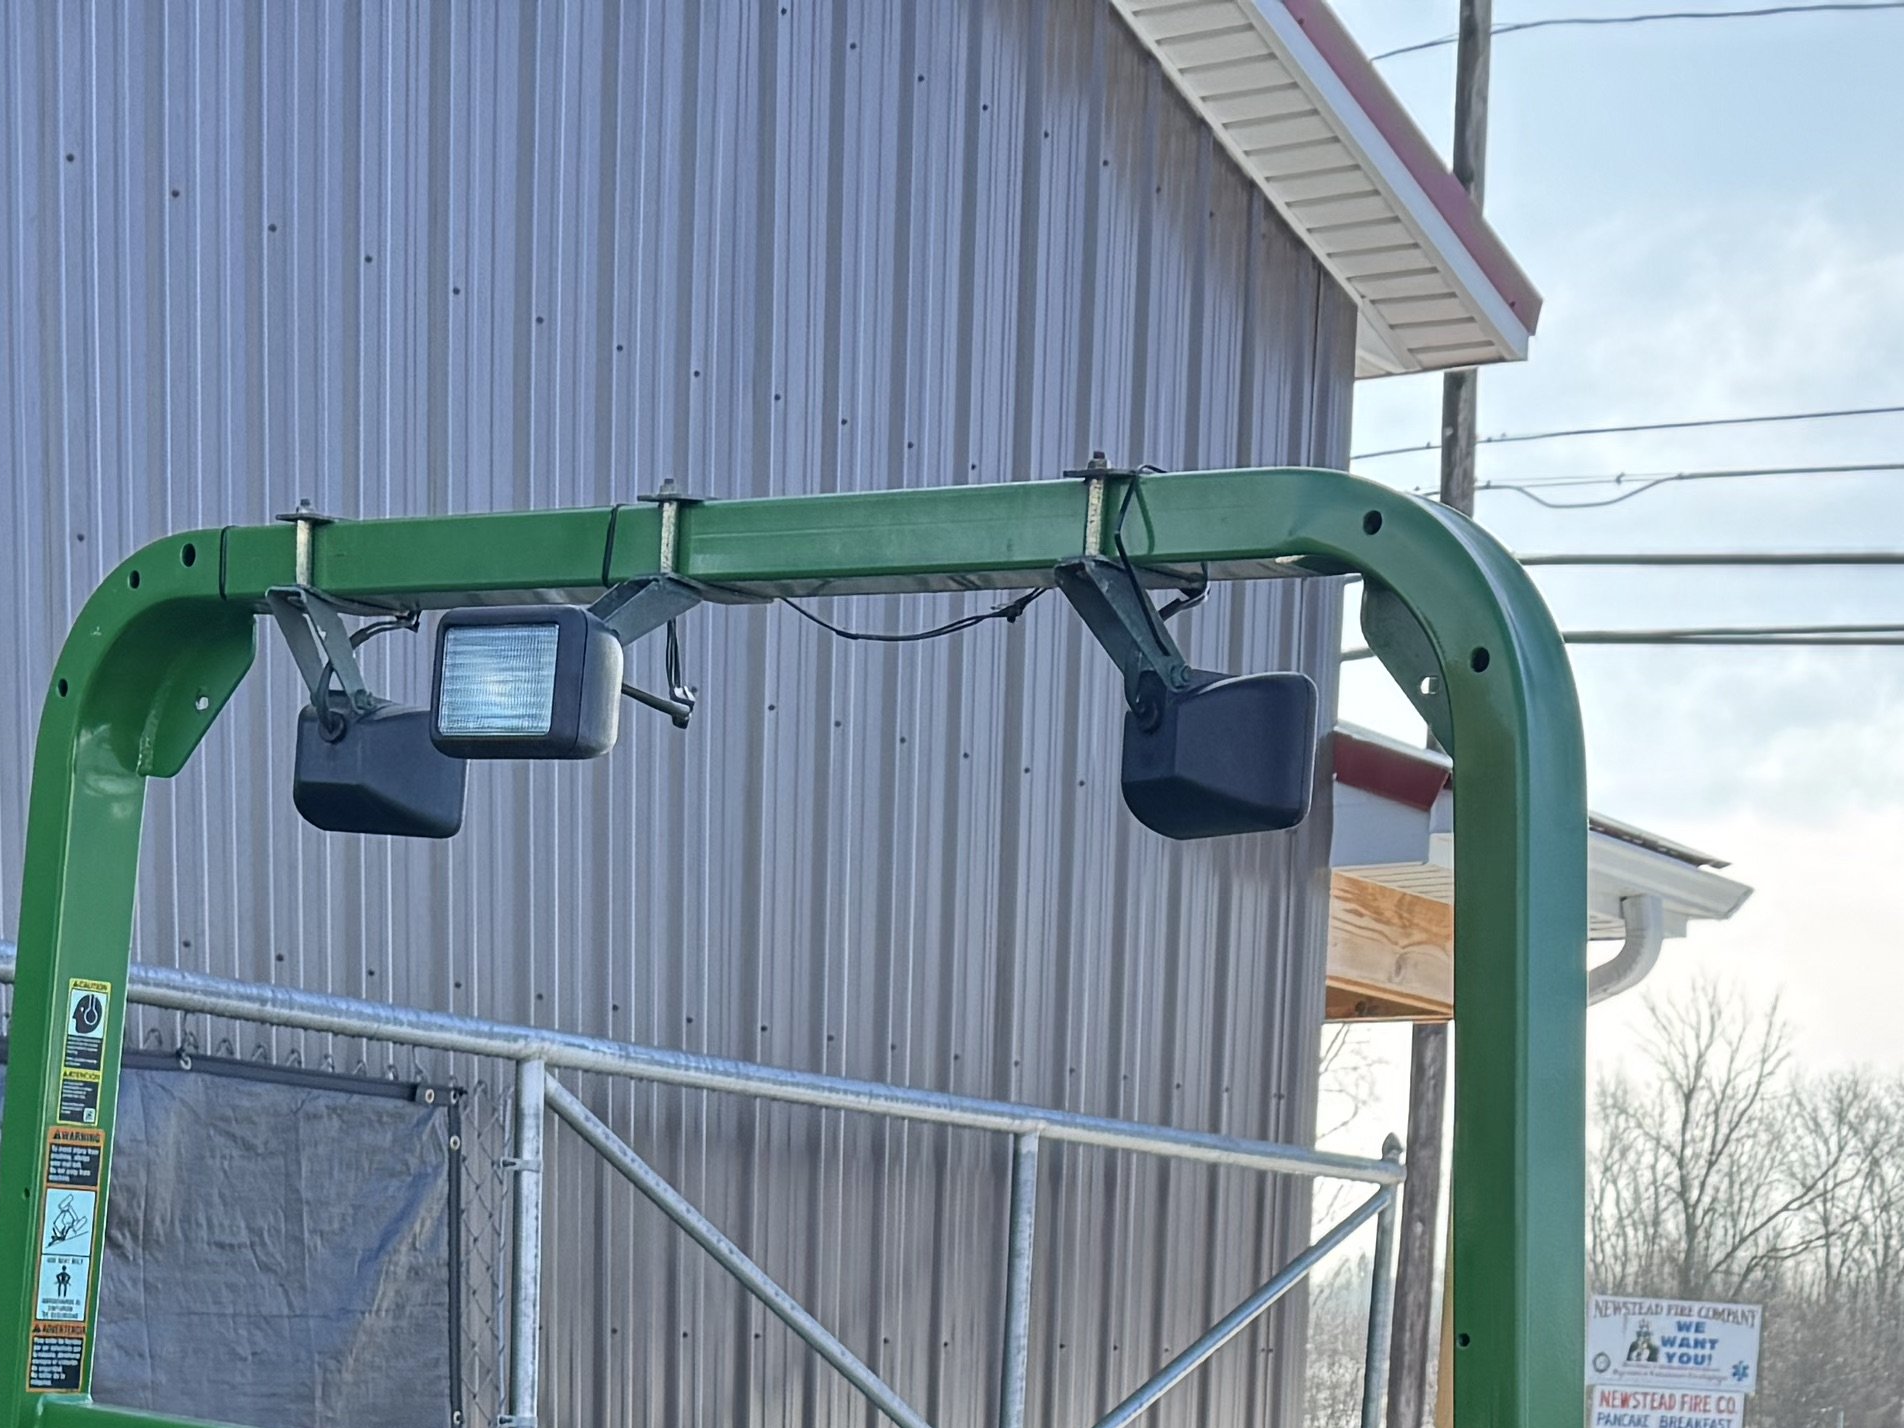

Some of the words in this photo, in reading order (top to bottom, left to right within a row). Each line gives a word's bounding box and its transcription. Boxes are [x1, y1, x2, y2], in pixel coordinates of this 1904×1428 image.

[1594, 1299, 1663, 1318] NEWSTEAD
[1666, 1302, 1694, 1317] FIRE
[1697, 1304, 1758, 1328] COMPANY
[1676, 1320, 1706, 1333] WE
[1661, 1335, 1719, 1350] WANT
[1665, 1352, 1712, 1366] YOU!
[1599, 1390, 1676, 1411] NEWSTEAD
[1680, 1394, 1711, 1413] FIRE
[1596, 1412, 1651, 1428] PANCAKE
